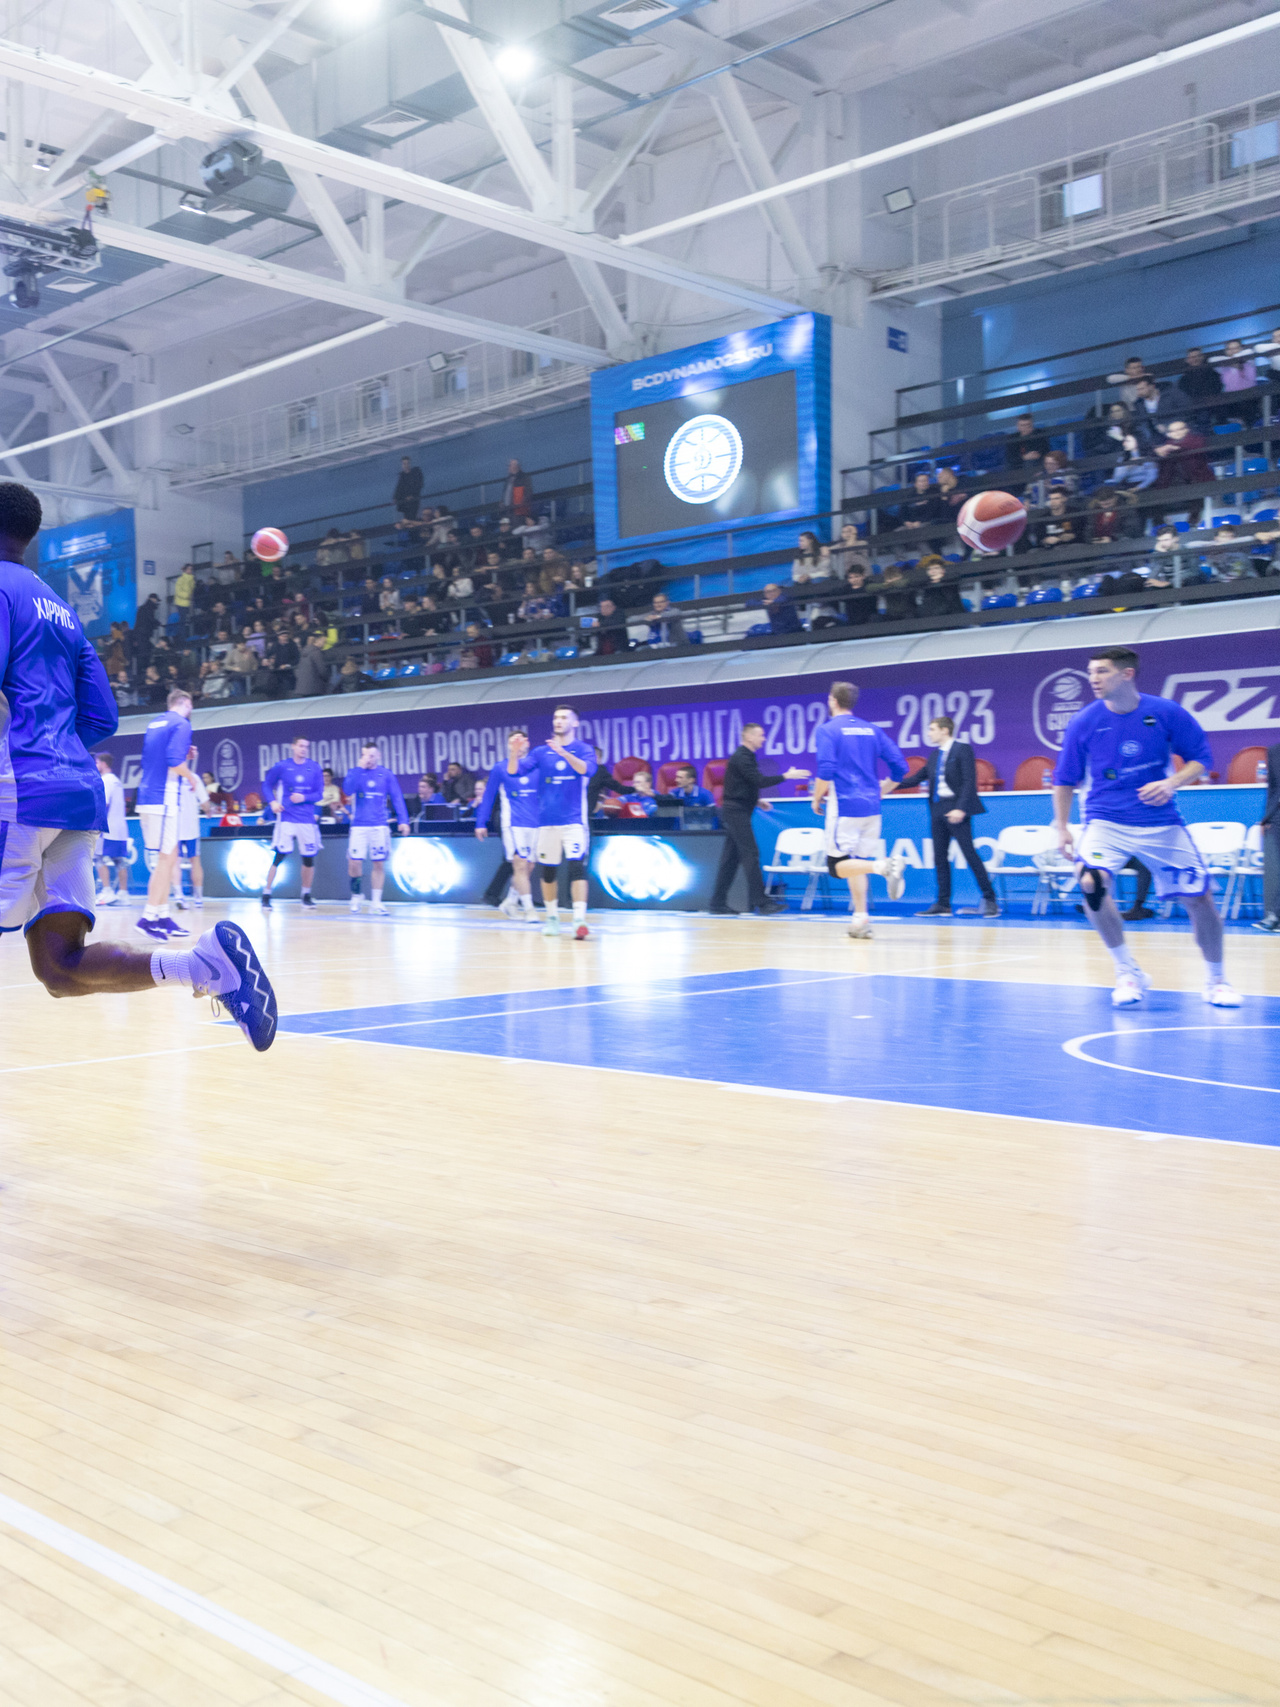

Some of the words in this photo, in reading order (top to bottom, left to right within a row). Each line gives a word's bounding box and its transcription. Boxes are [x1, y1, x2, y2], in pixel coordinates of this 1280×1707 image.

[32, 597, 75, 630] ХАРРИС
[308, 732, 429, 779] ЕМПОНАТ
[434, 725, 528, 773] РОССИ
